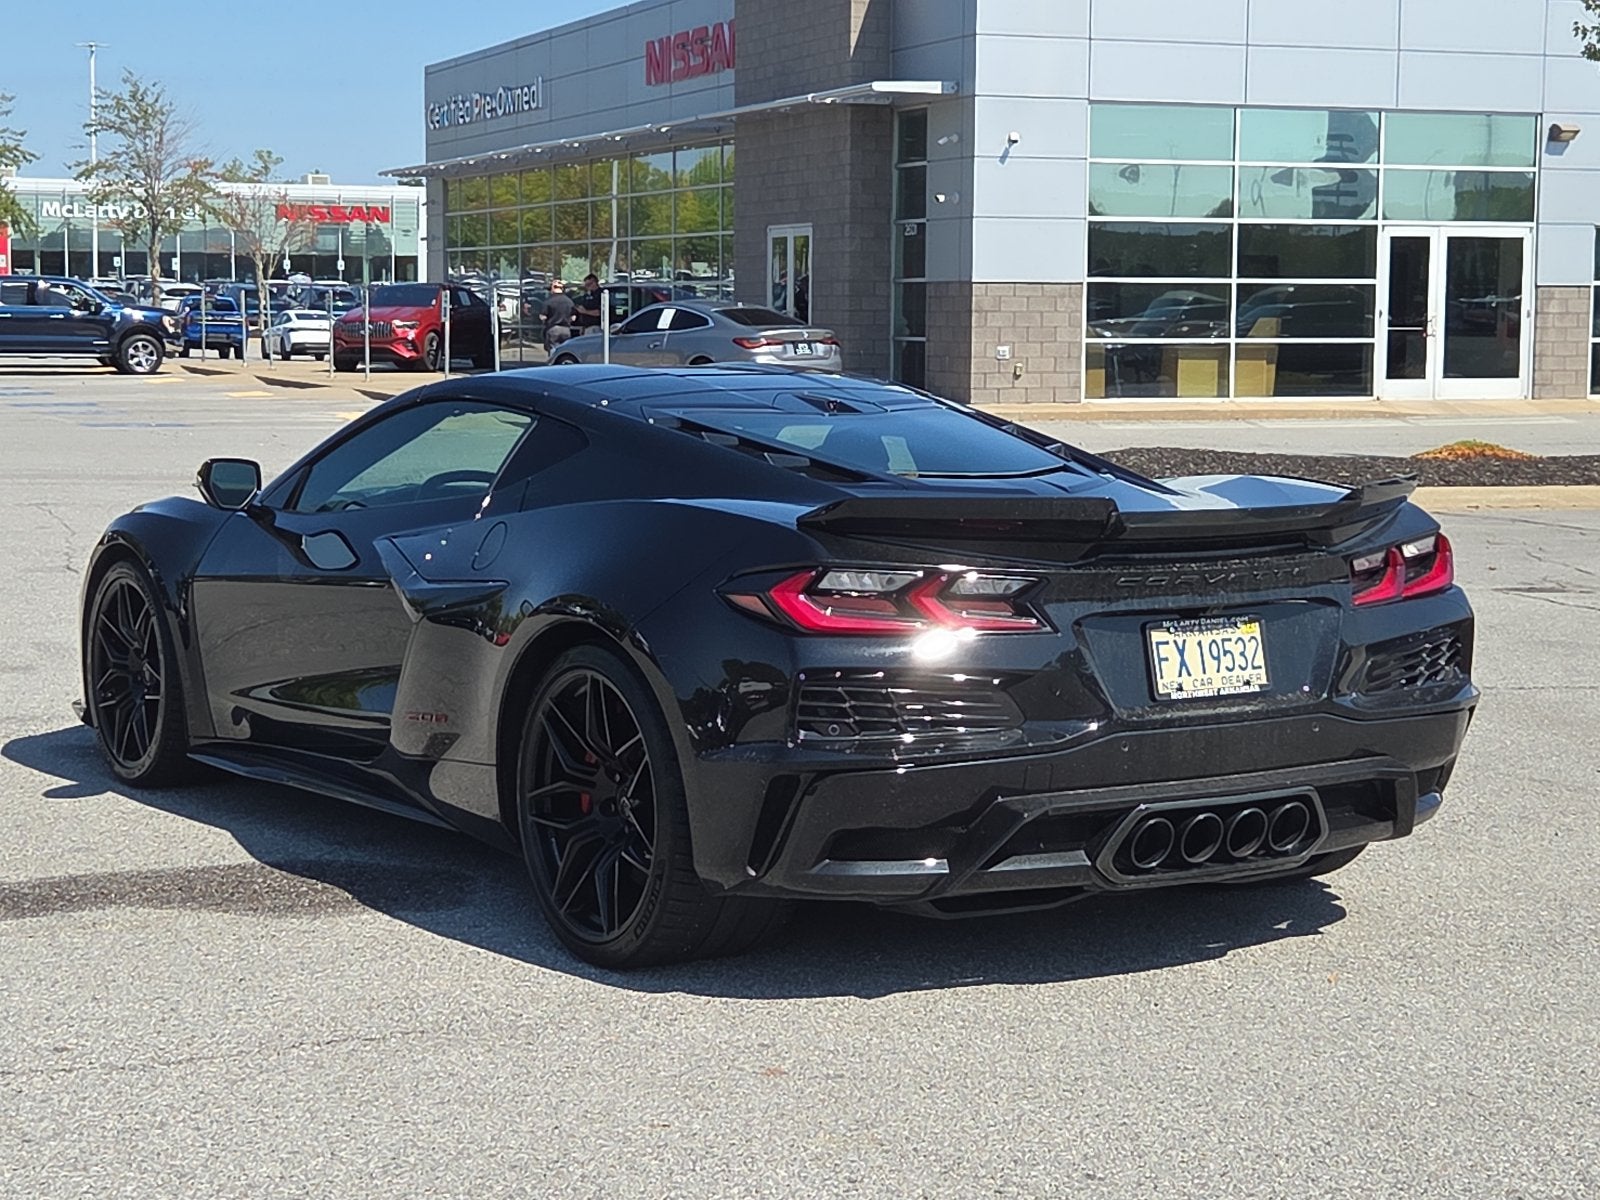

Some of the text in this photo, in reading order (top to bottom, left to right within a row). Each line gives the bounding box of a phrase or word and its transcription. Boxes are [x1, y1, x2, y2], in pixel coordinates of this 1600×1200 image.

[427, 76, 543, 130] Certified Pre-Owned
[41, 201, 200, 220] McLarty Dnel
[1192, 677, 1213, 689] CAR
[1221, 674, 1262, 685] DEALER
